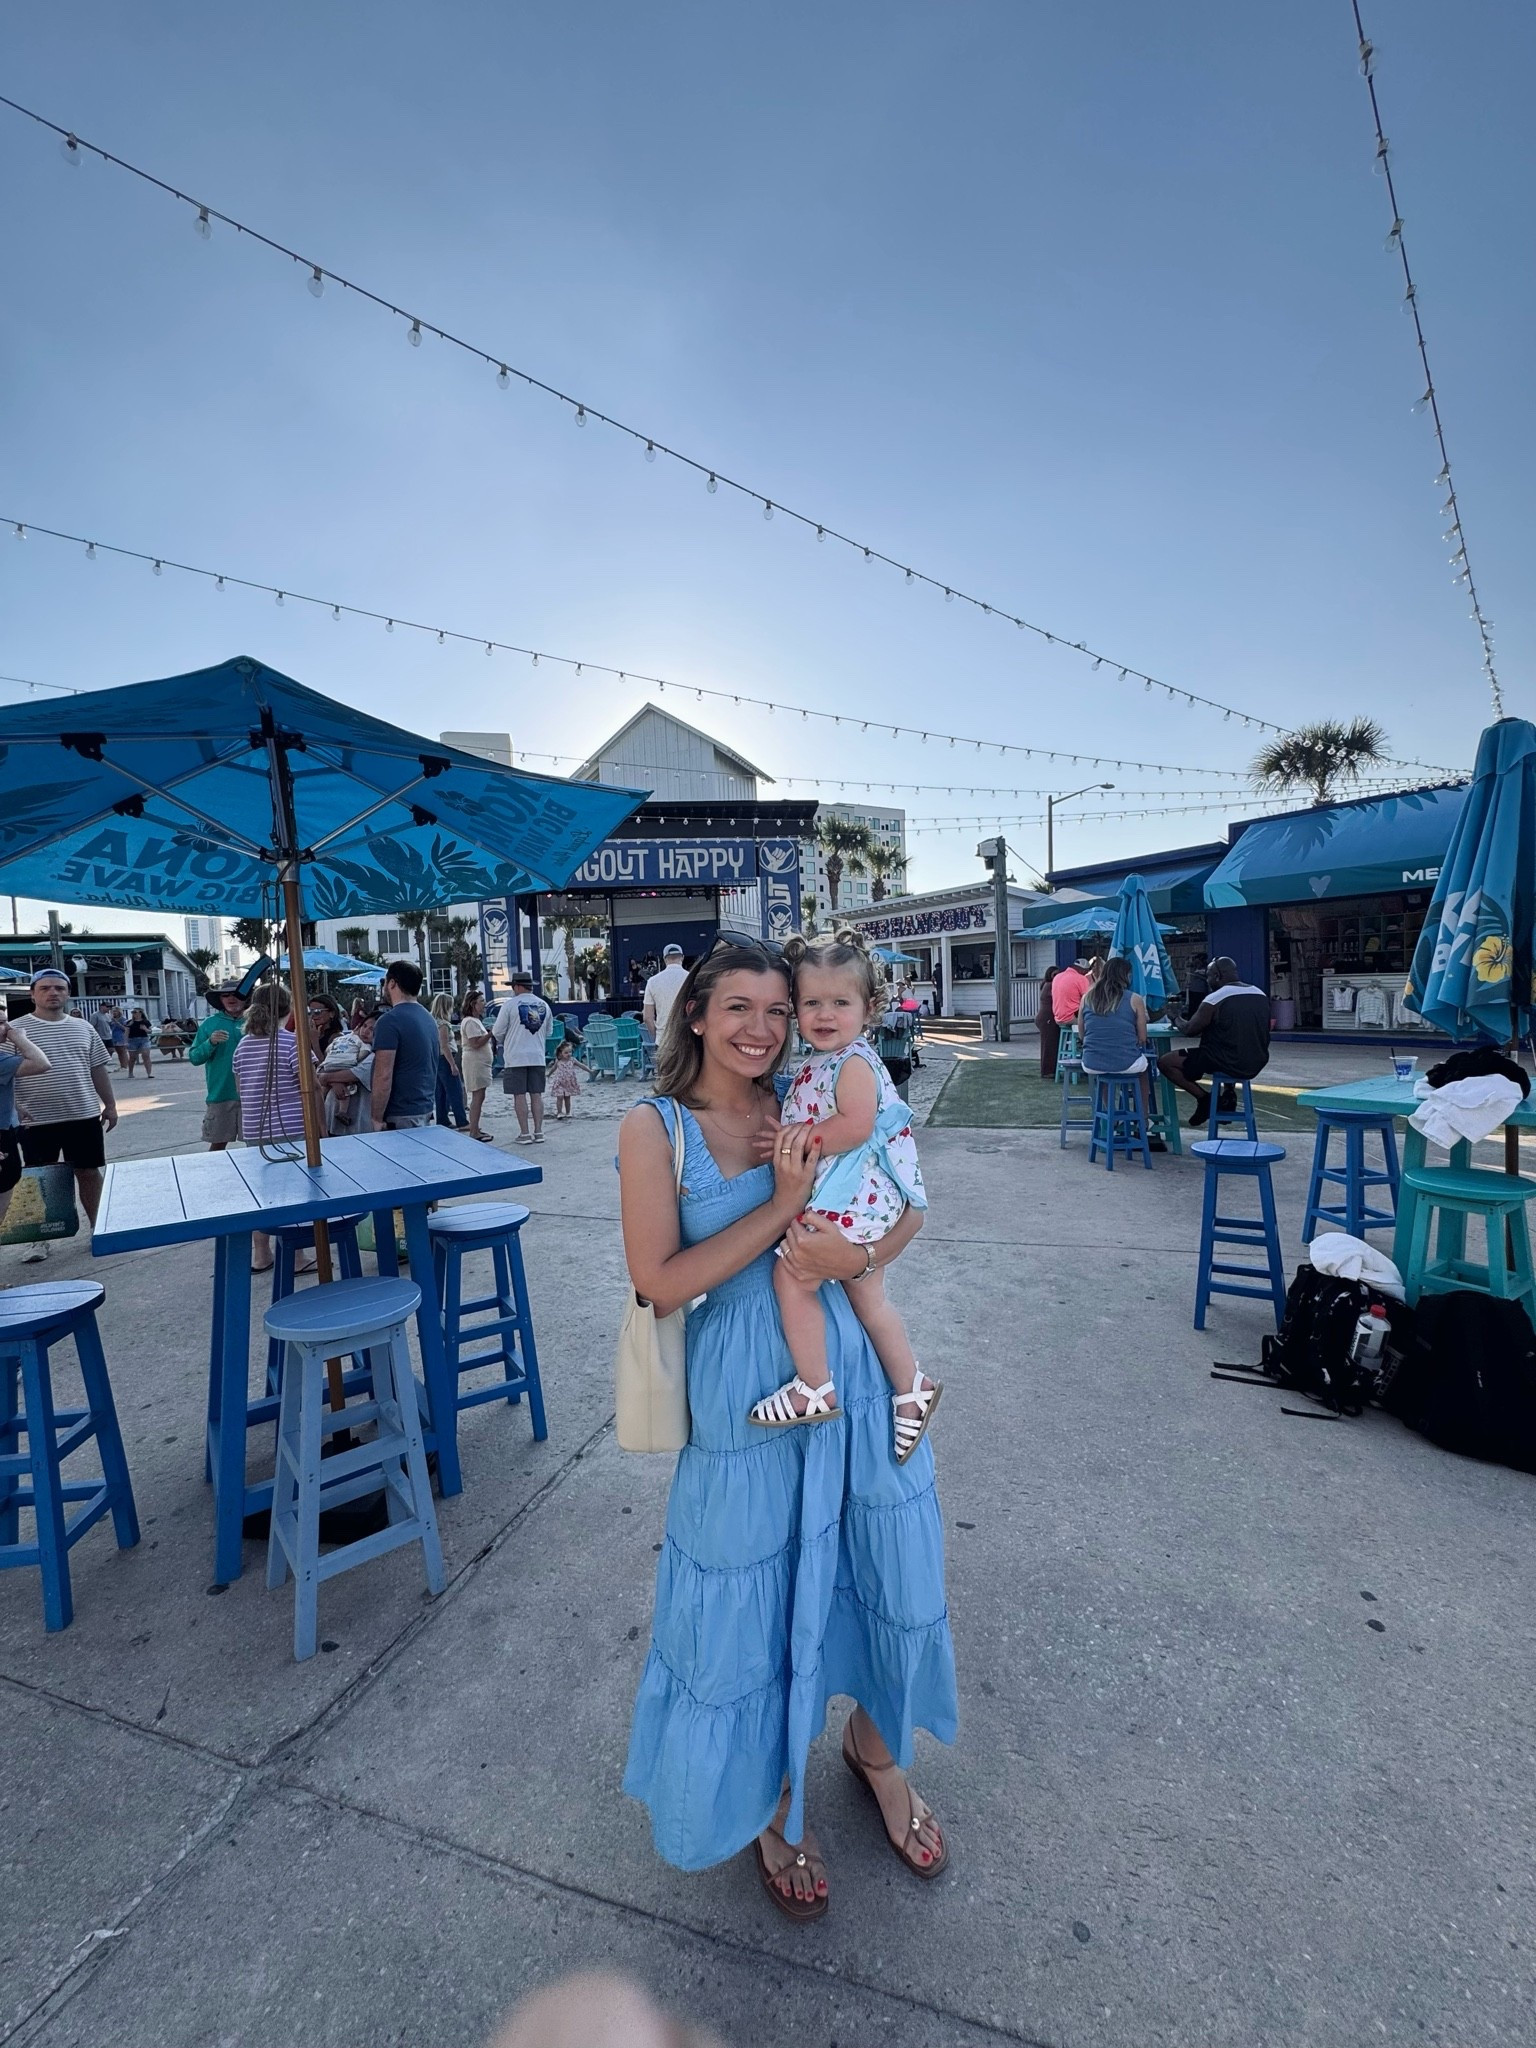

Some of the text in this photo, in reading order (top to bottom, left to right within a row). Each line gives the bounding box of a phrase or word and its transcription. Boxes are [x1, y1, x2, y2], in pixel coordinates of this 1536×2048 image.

[659, 848, 744, 880] HAPPY
[1402, 867, 1443, 883] ME
[890, 903, 988, 938] HANGOUT
